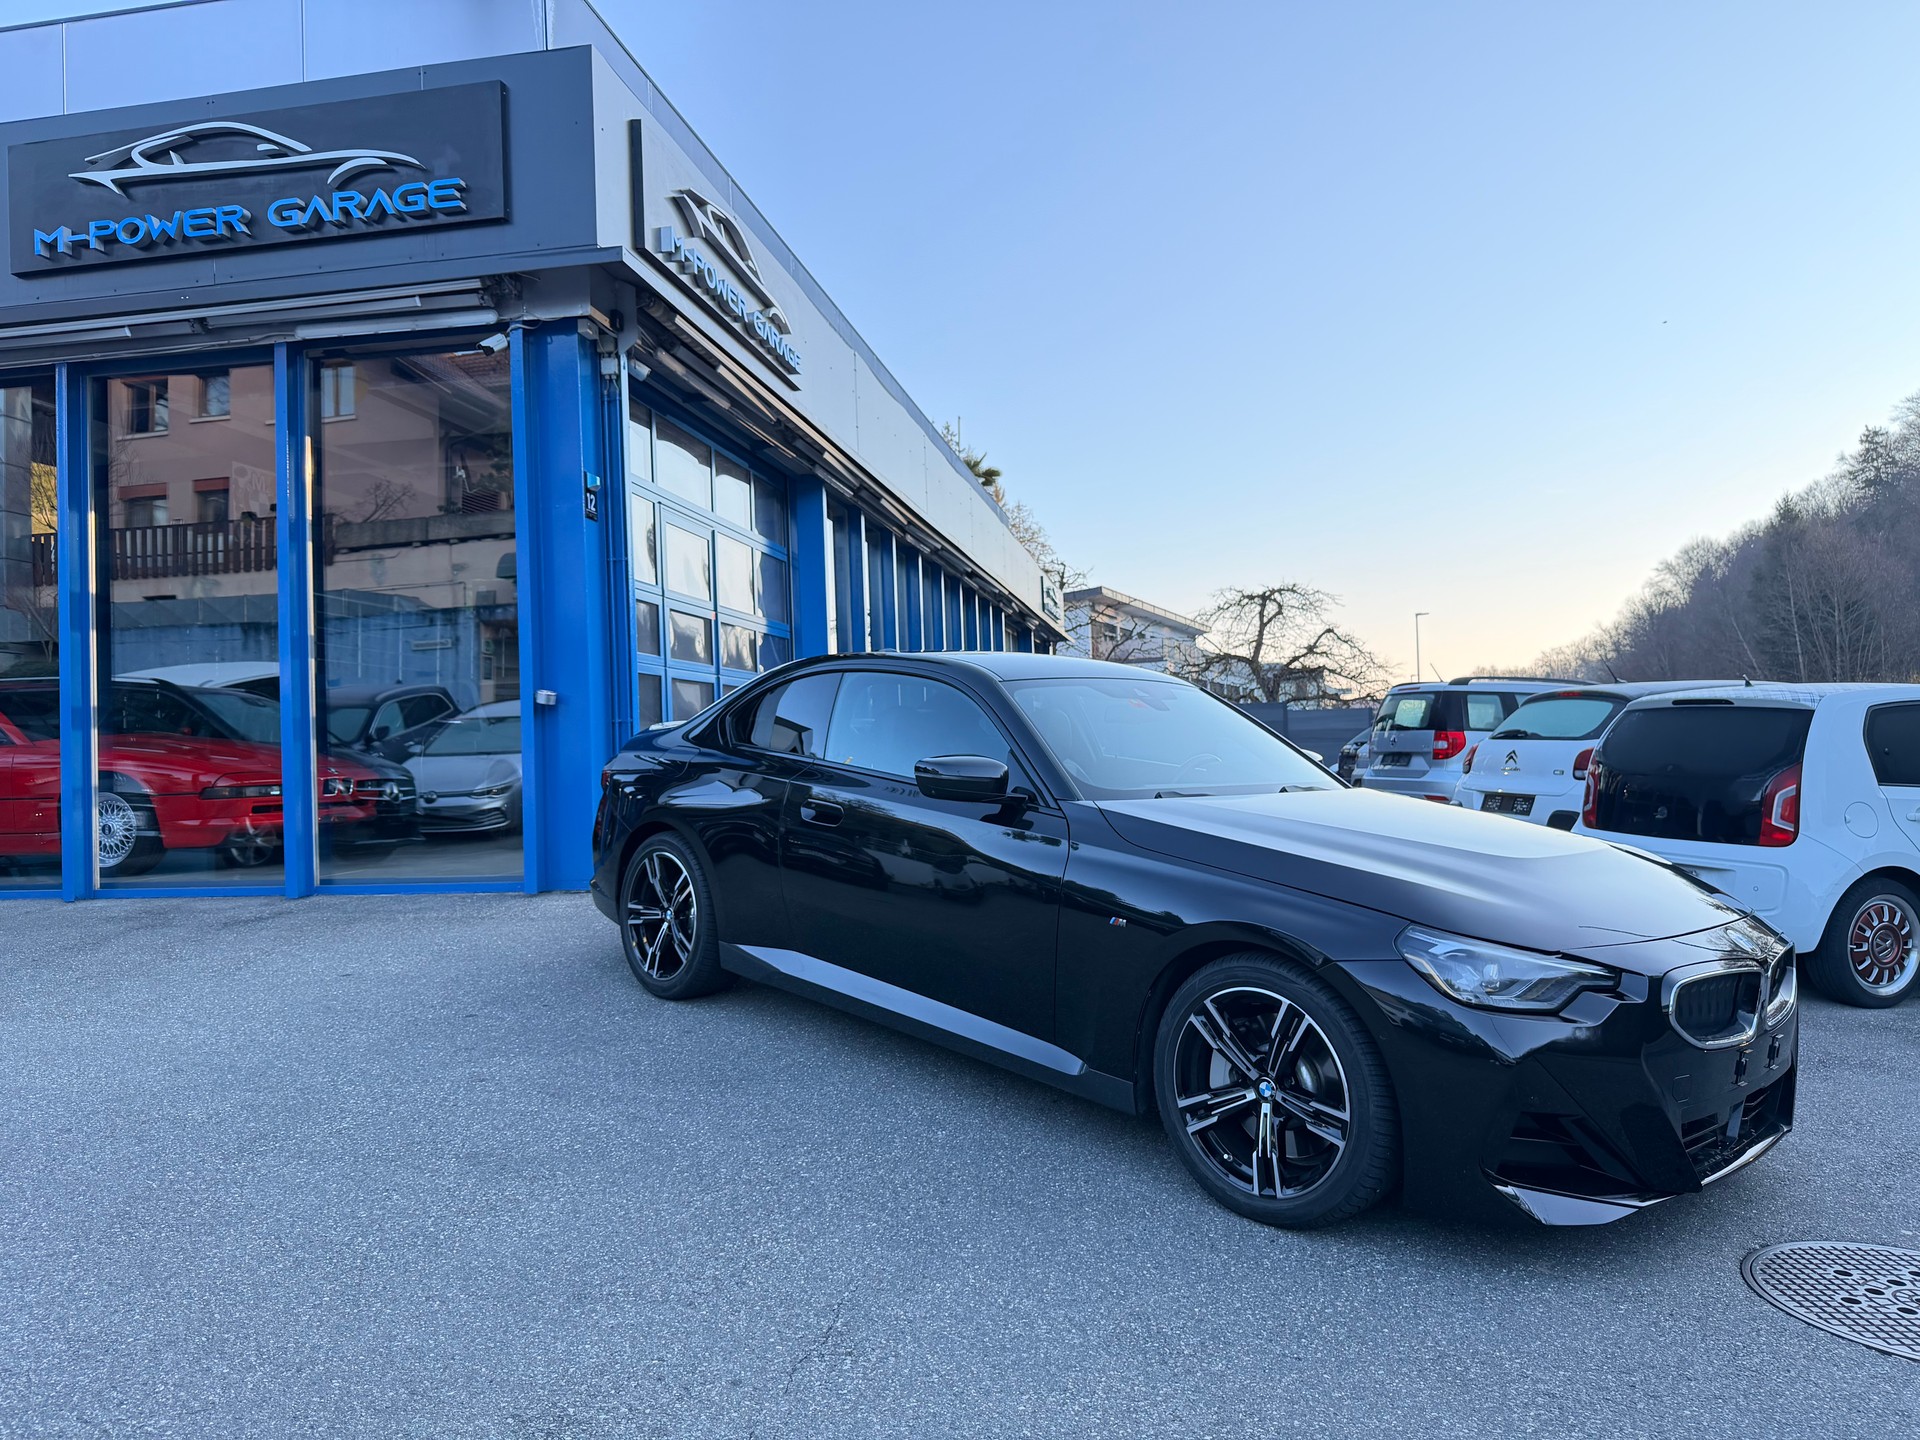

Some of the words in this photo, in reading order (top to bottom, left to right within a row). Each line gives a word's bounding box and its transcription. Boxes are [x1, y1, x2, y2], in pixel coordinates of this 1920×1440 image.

[33, 204, 250, 258] M-POWER
[267, 177, 465, 228] GARAGE
[668, 229, 749, 323] M-POWER
[752, 309, 801, 373] GARAGE
[586, 492, 596, 512] 12
